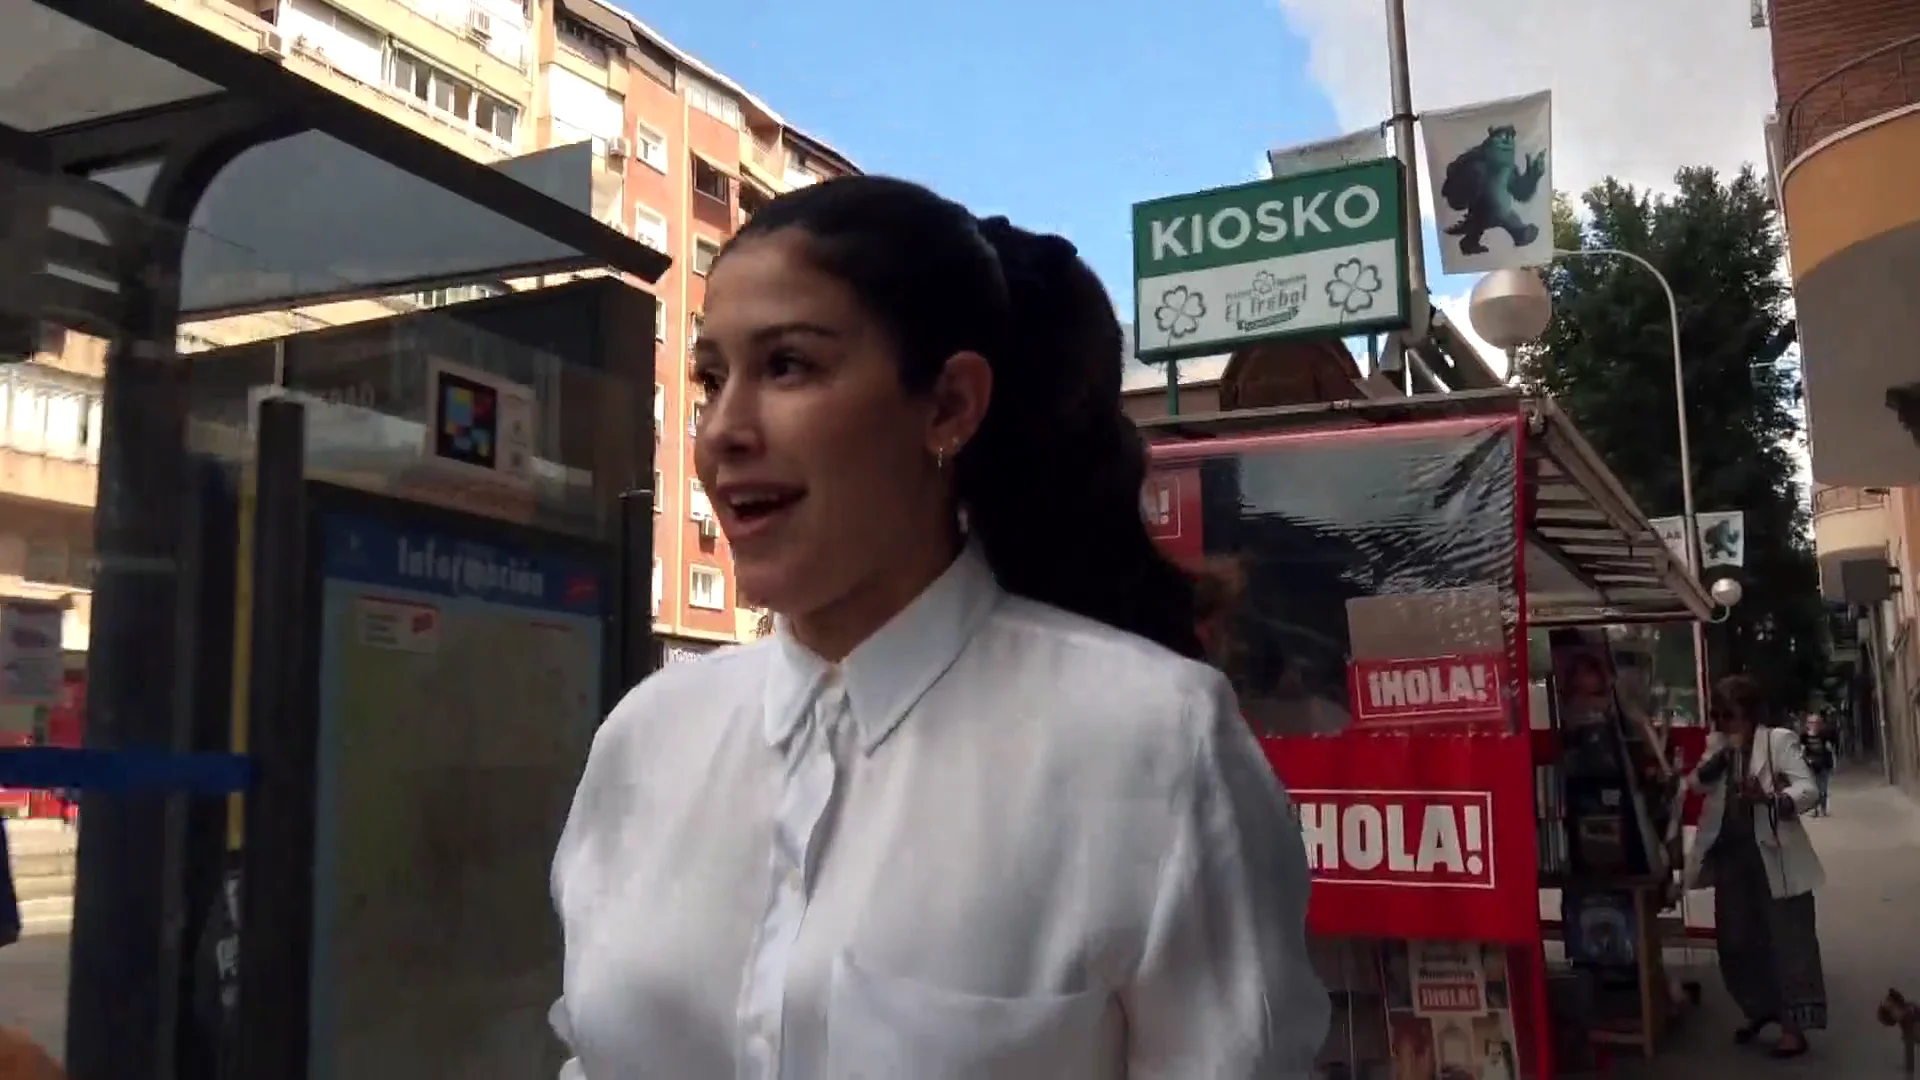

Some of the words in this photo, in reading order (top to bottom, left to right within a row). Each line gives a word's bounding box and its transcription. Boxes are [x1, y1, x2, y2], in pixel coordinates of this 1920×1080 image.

[1152, 184, 1380, 261] KIOSKO
[1368, 664, 1487, 707] ¡HOLA!
[1296, 803, 1484, 875] HOLA!
